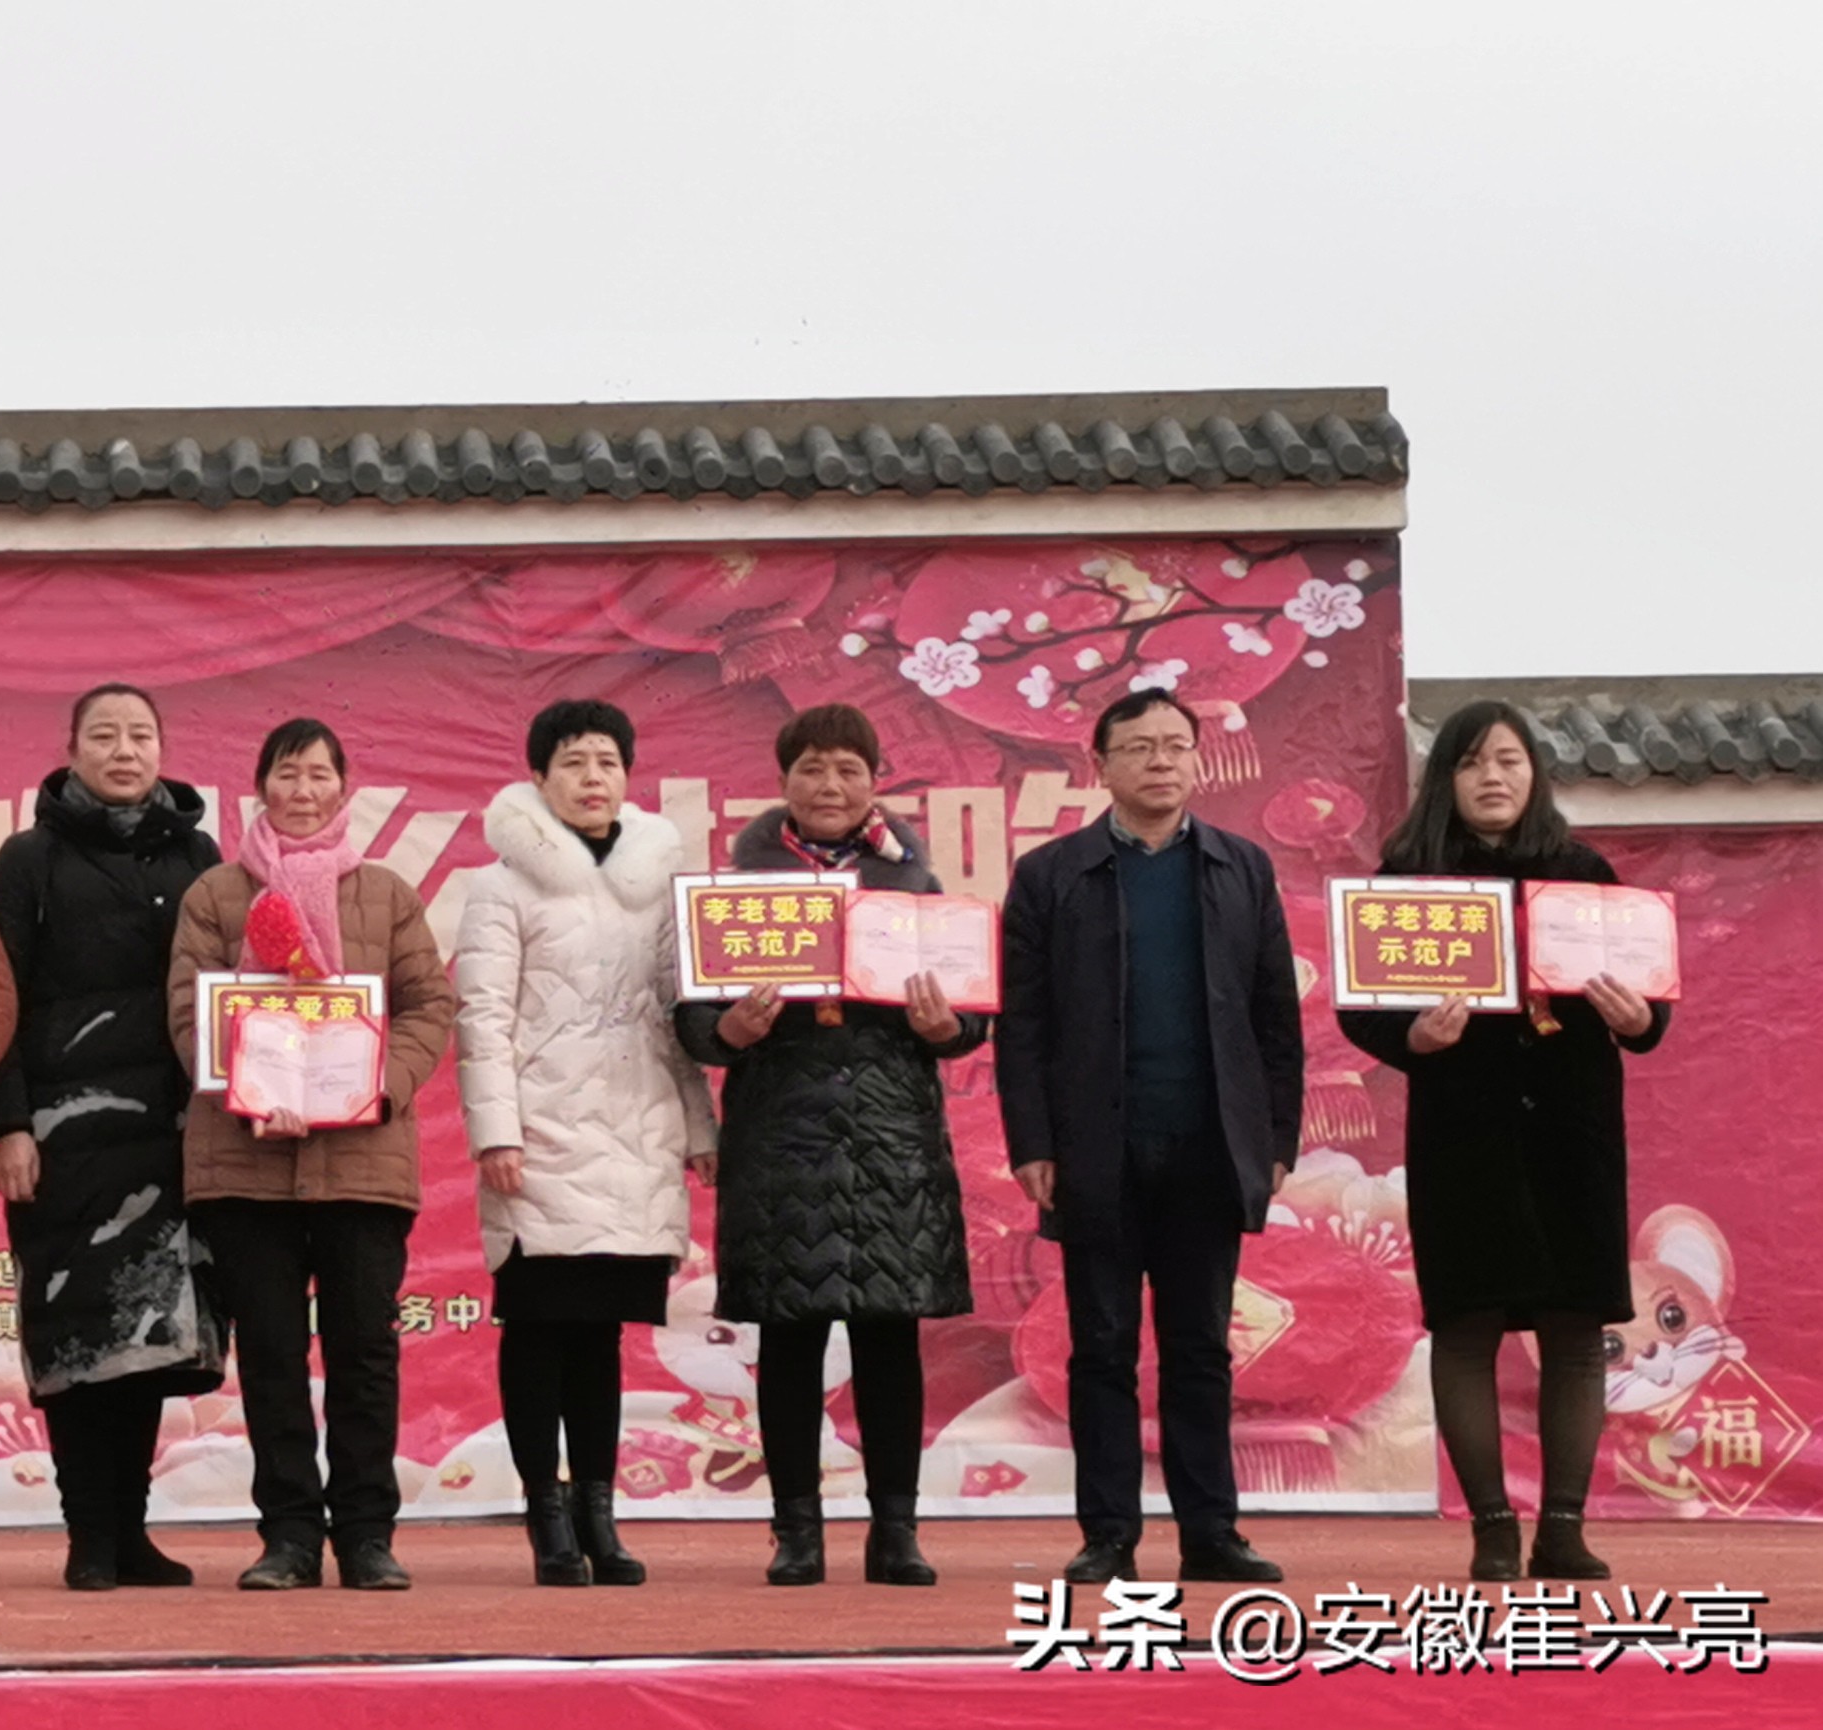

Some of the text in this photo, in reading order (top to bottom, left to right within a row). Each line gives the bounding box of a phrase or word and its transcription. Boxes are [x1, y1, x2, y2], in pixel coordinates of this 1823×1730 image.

[703, 895, 834, 924] 孝老爱亲
[1358, 903, 1489, 933] 孝老爱亲
[722, 930, 819, 957] 示范户
[1378, 938, 1472, 966] 示范户
[1692, 1395, 1762, 1468] 福
